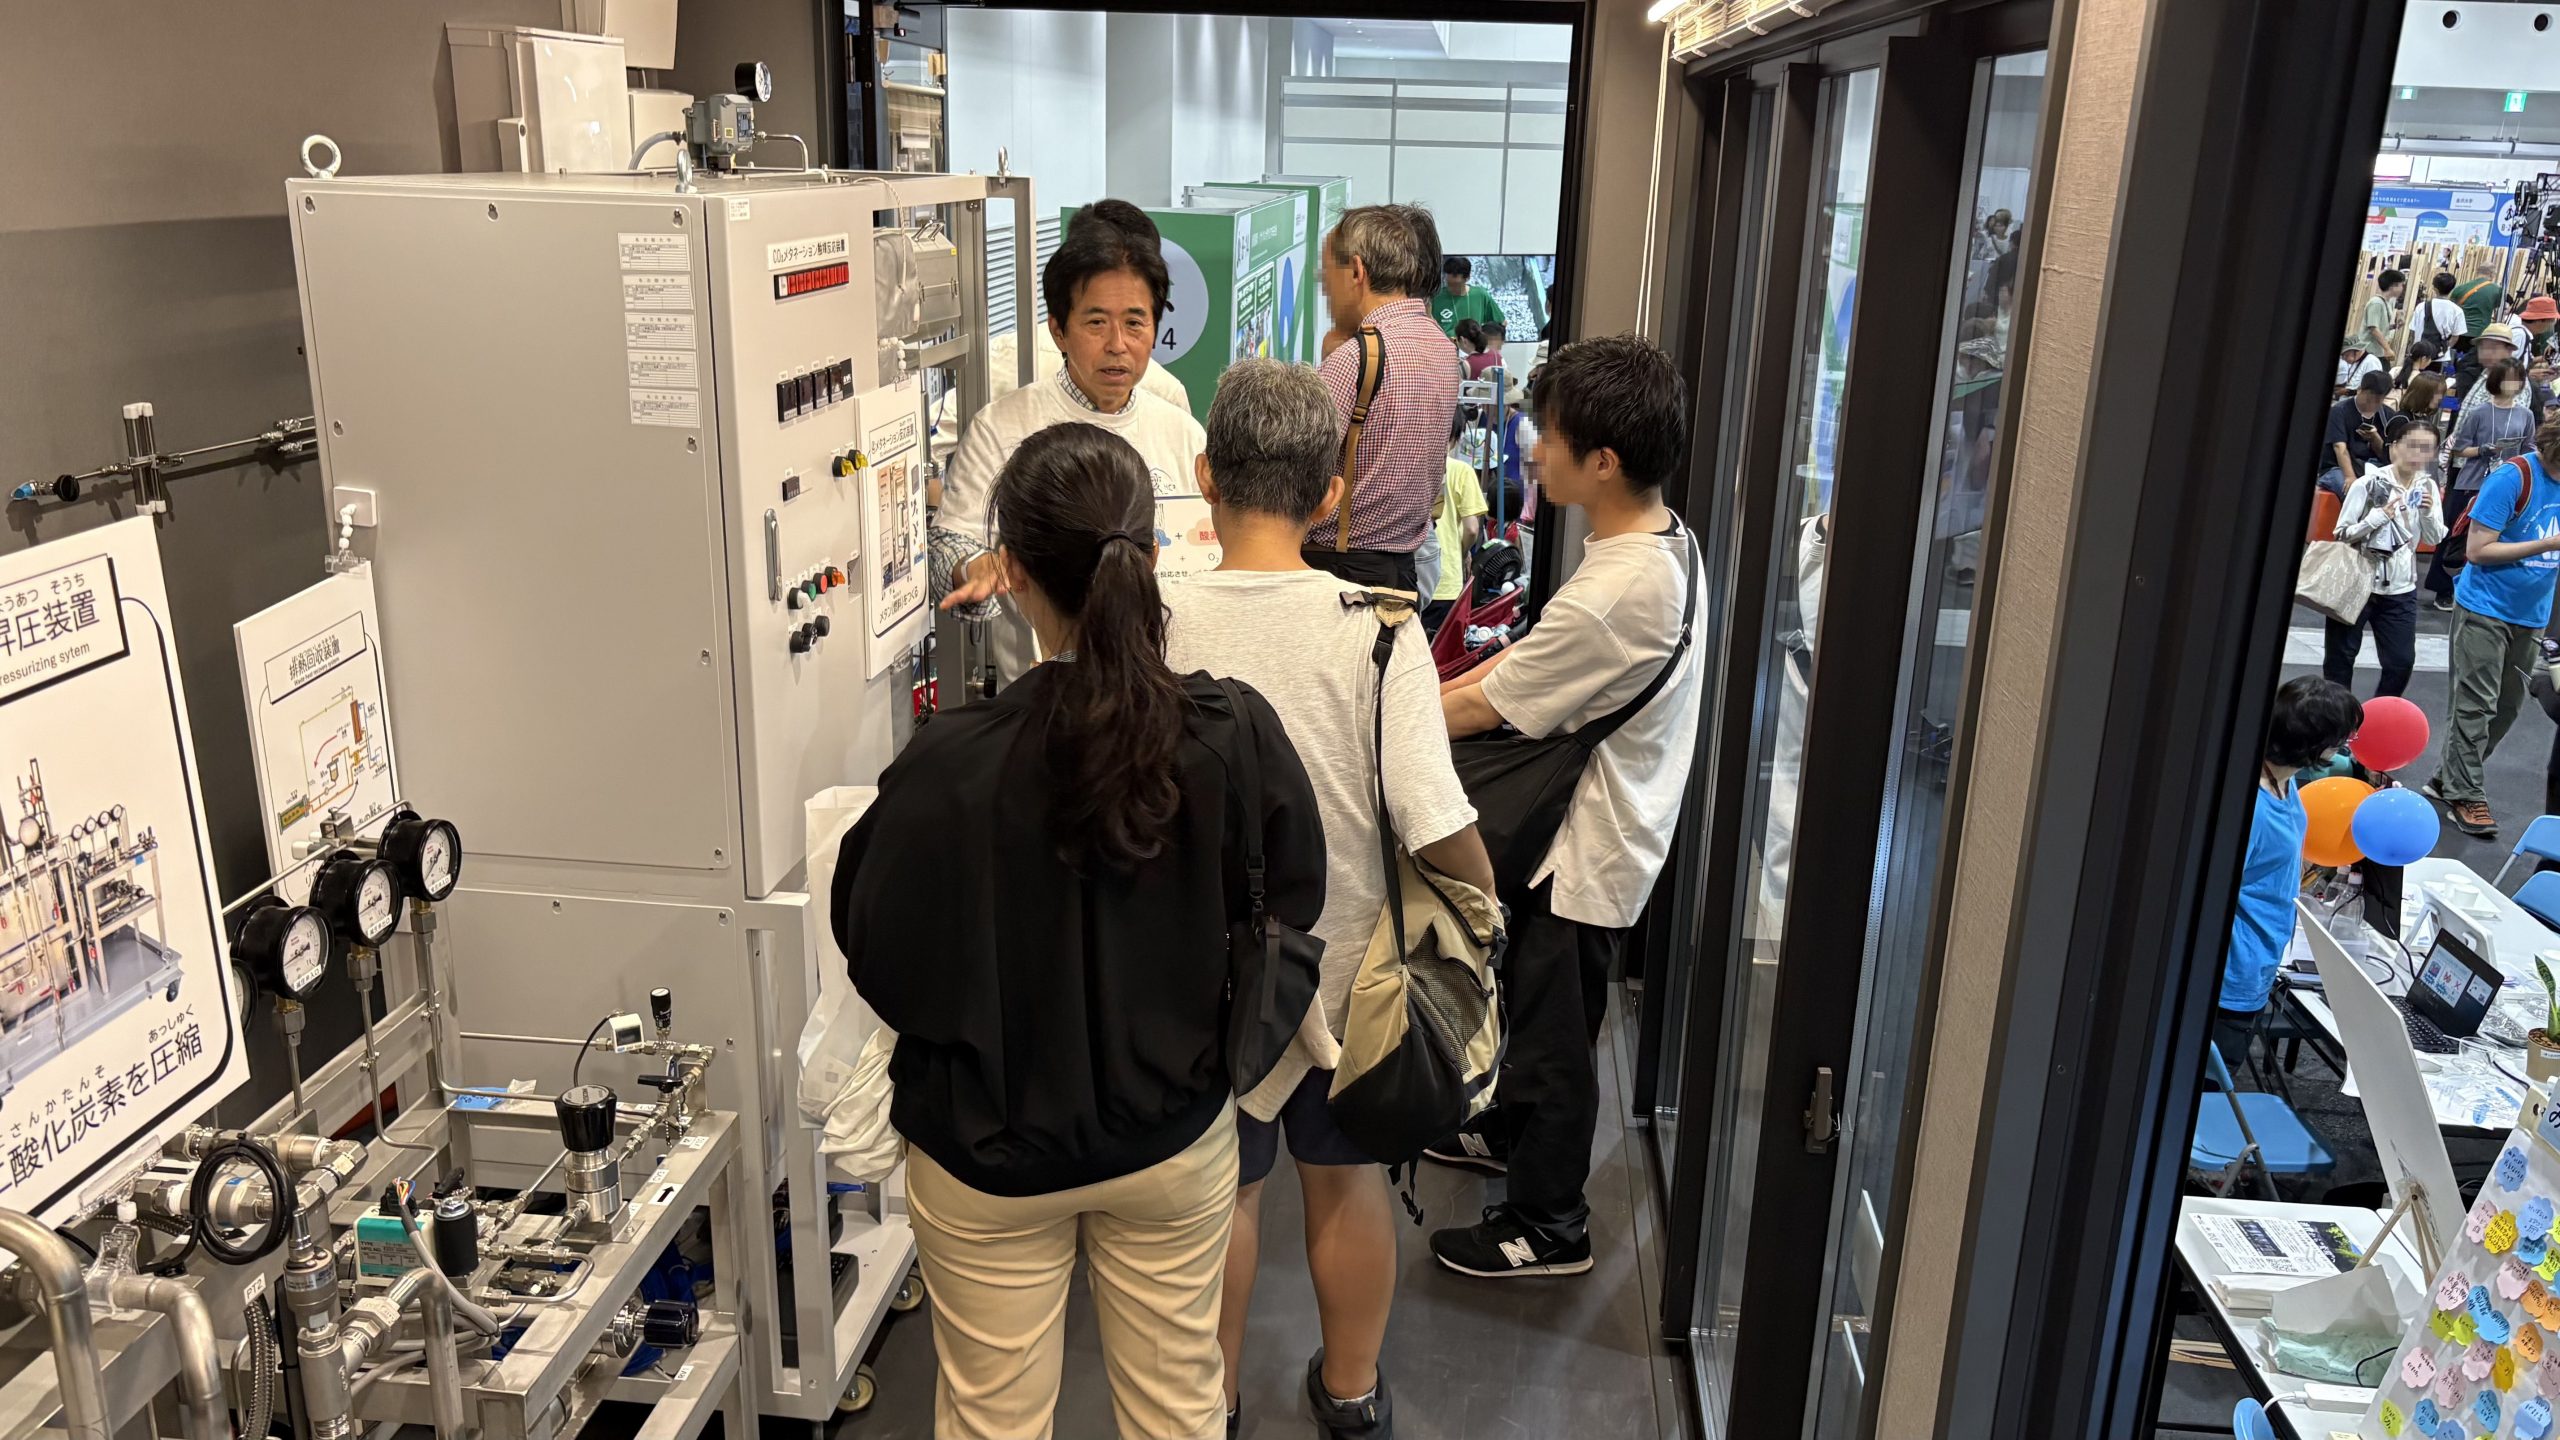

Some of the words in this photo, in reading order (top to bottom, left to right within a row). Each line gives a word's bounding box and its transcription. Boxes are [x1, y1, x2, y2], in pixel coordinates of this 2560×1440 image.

[50, 572, 86, 595] そうち
[59, 642, 91, 664] sytem
[0, 1064, 105, 1148] さんかたんそ
[148, 1003, 194, 1044] あっしゅく
[1458, 1132, 1492, 1157] N
[1498, 1236, 1538, 1268] N
[246, 1278, 263, 1300] PT2
